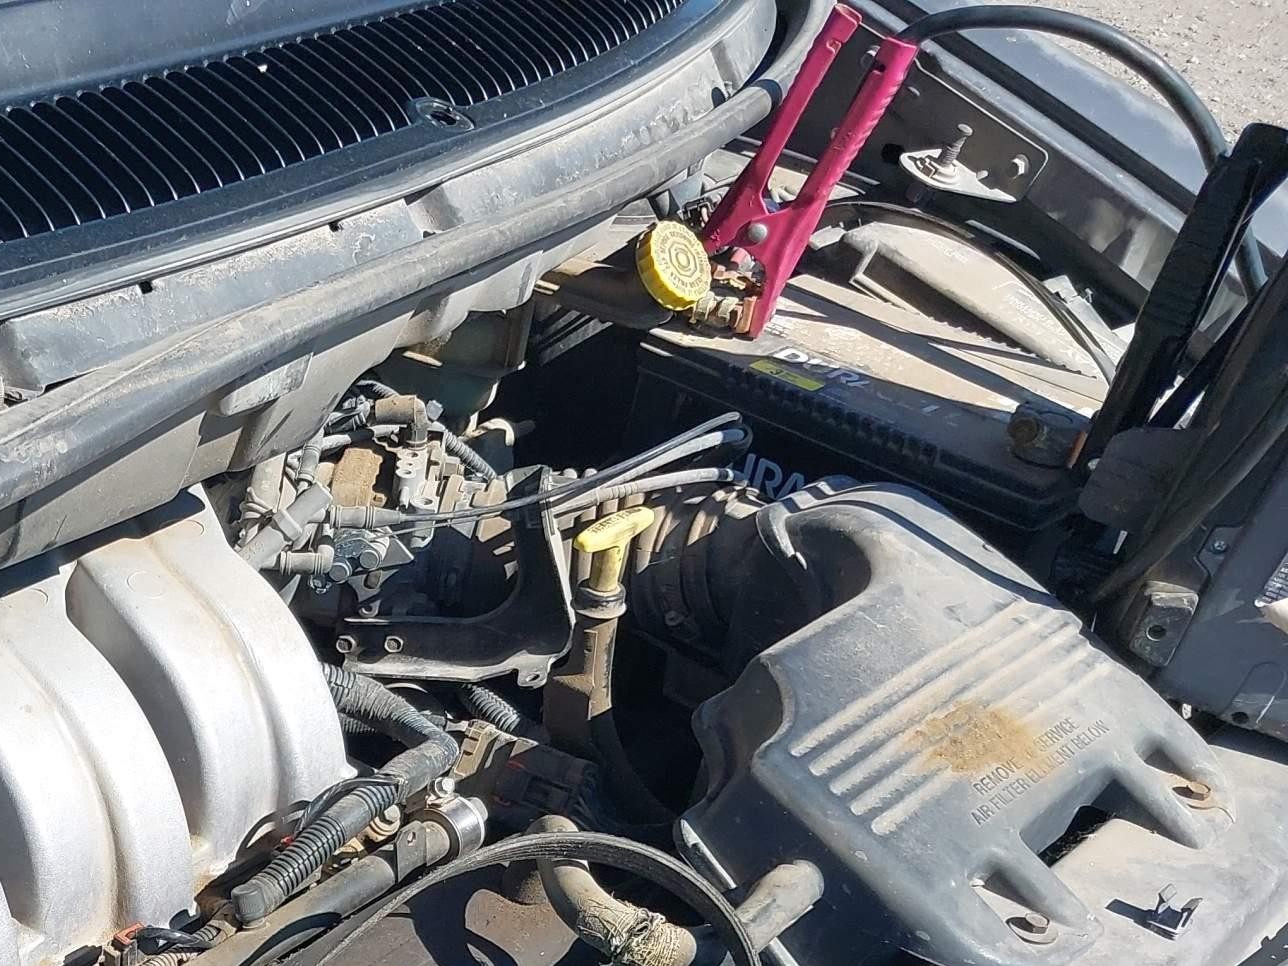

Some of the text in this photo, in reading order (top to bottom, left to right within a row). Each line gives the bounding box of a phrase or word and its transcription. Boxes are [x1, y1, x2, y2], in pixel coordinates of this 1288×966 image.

[1034, 717, 1080, 752] SERVICE
[973, 759, 1024, 796] REMOVE
[971, 804, 995, 825] AIR
[991, 777, 1032, 811] FILTER
